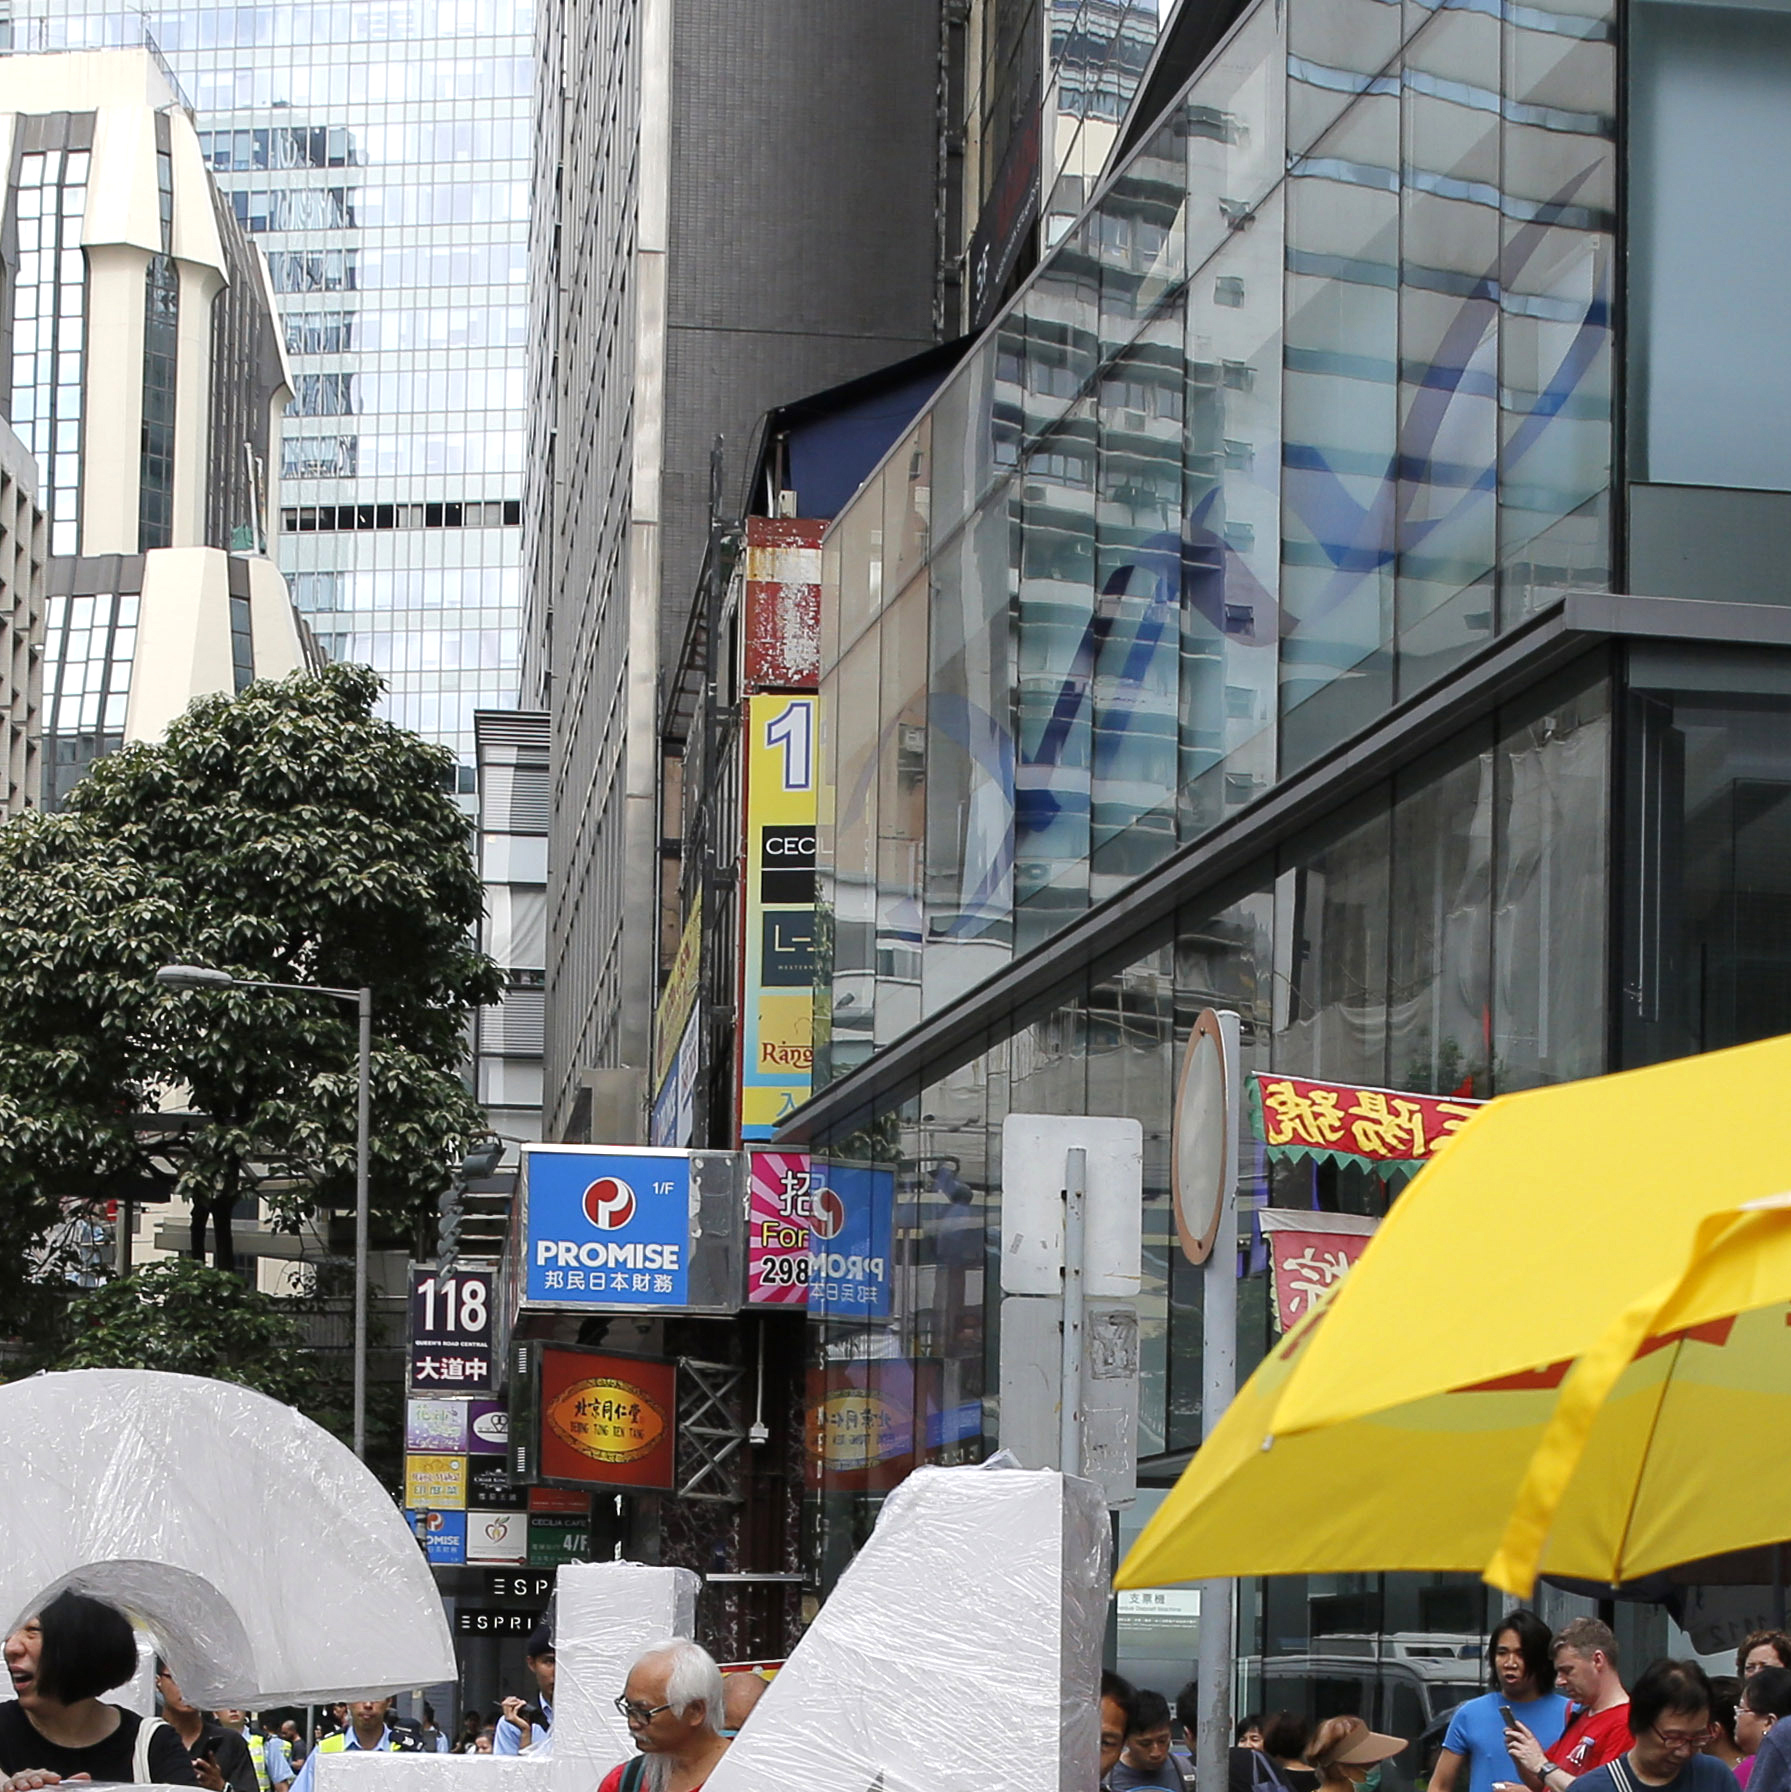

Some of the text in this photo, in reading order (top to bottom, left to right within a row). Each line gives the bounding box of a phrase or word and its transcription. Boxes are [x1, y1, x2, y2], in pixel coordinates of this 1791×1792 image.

[652, 1182, 675, 1195] 1/F
[761, 1222, 809, 1248] For
[537, 1240, 679, 1270] PROMISE
[544, 1270, 673, 1293] 邦民日本財務
[418, 1279, 487, 1332] 118
[416, 1356, 487, 1381] 大道中
[427, 1536, 460, 1546] OMISE
